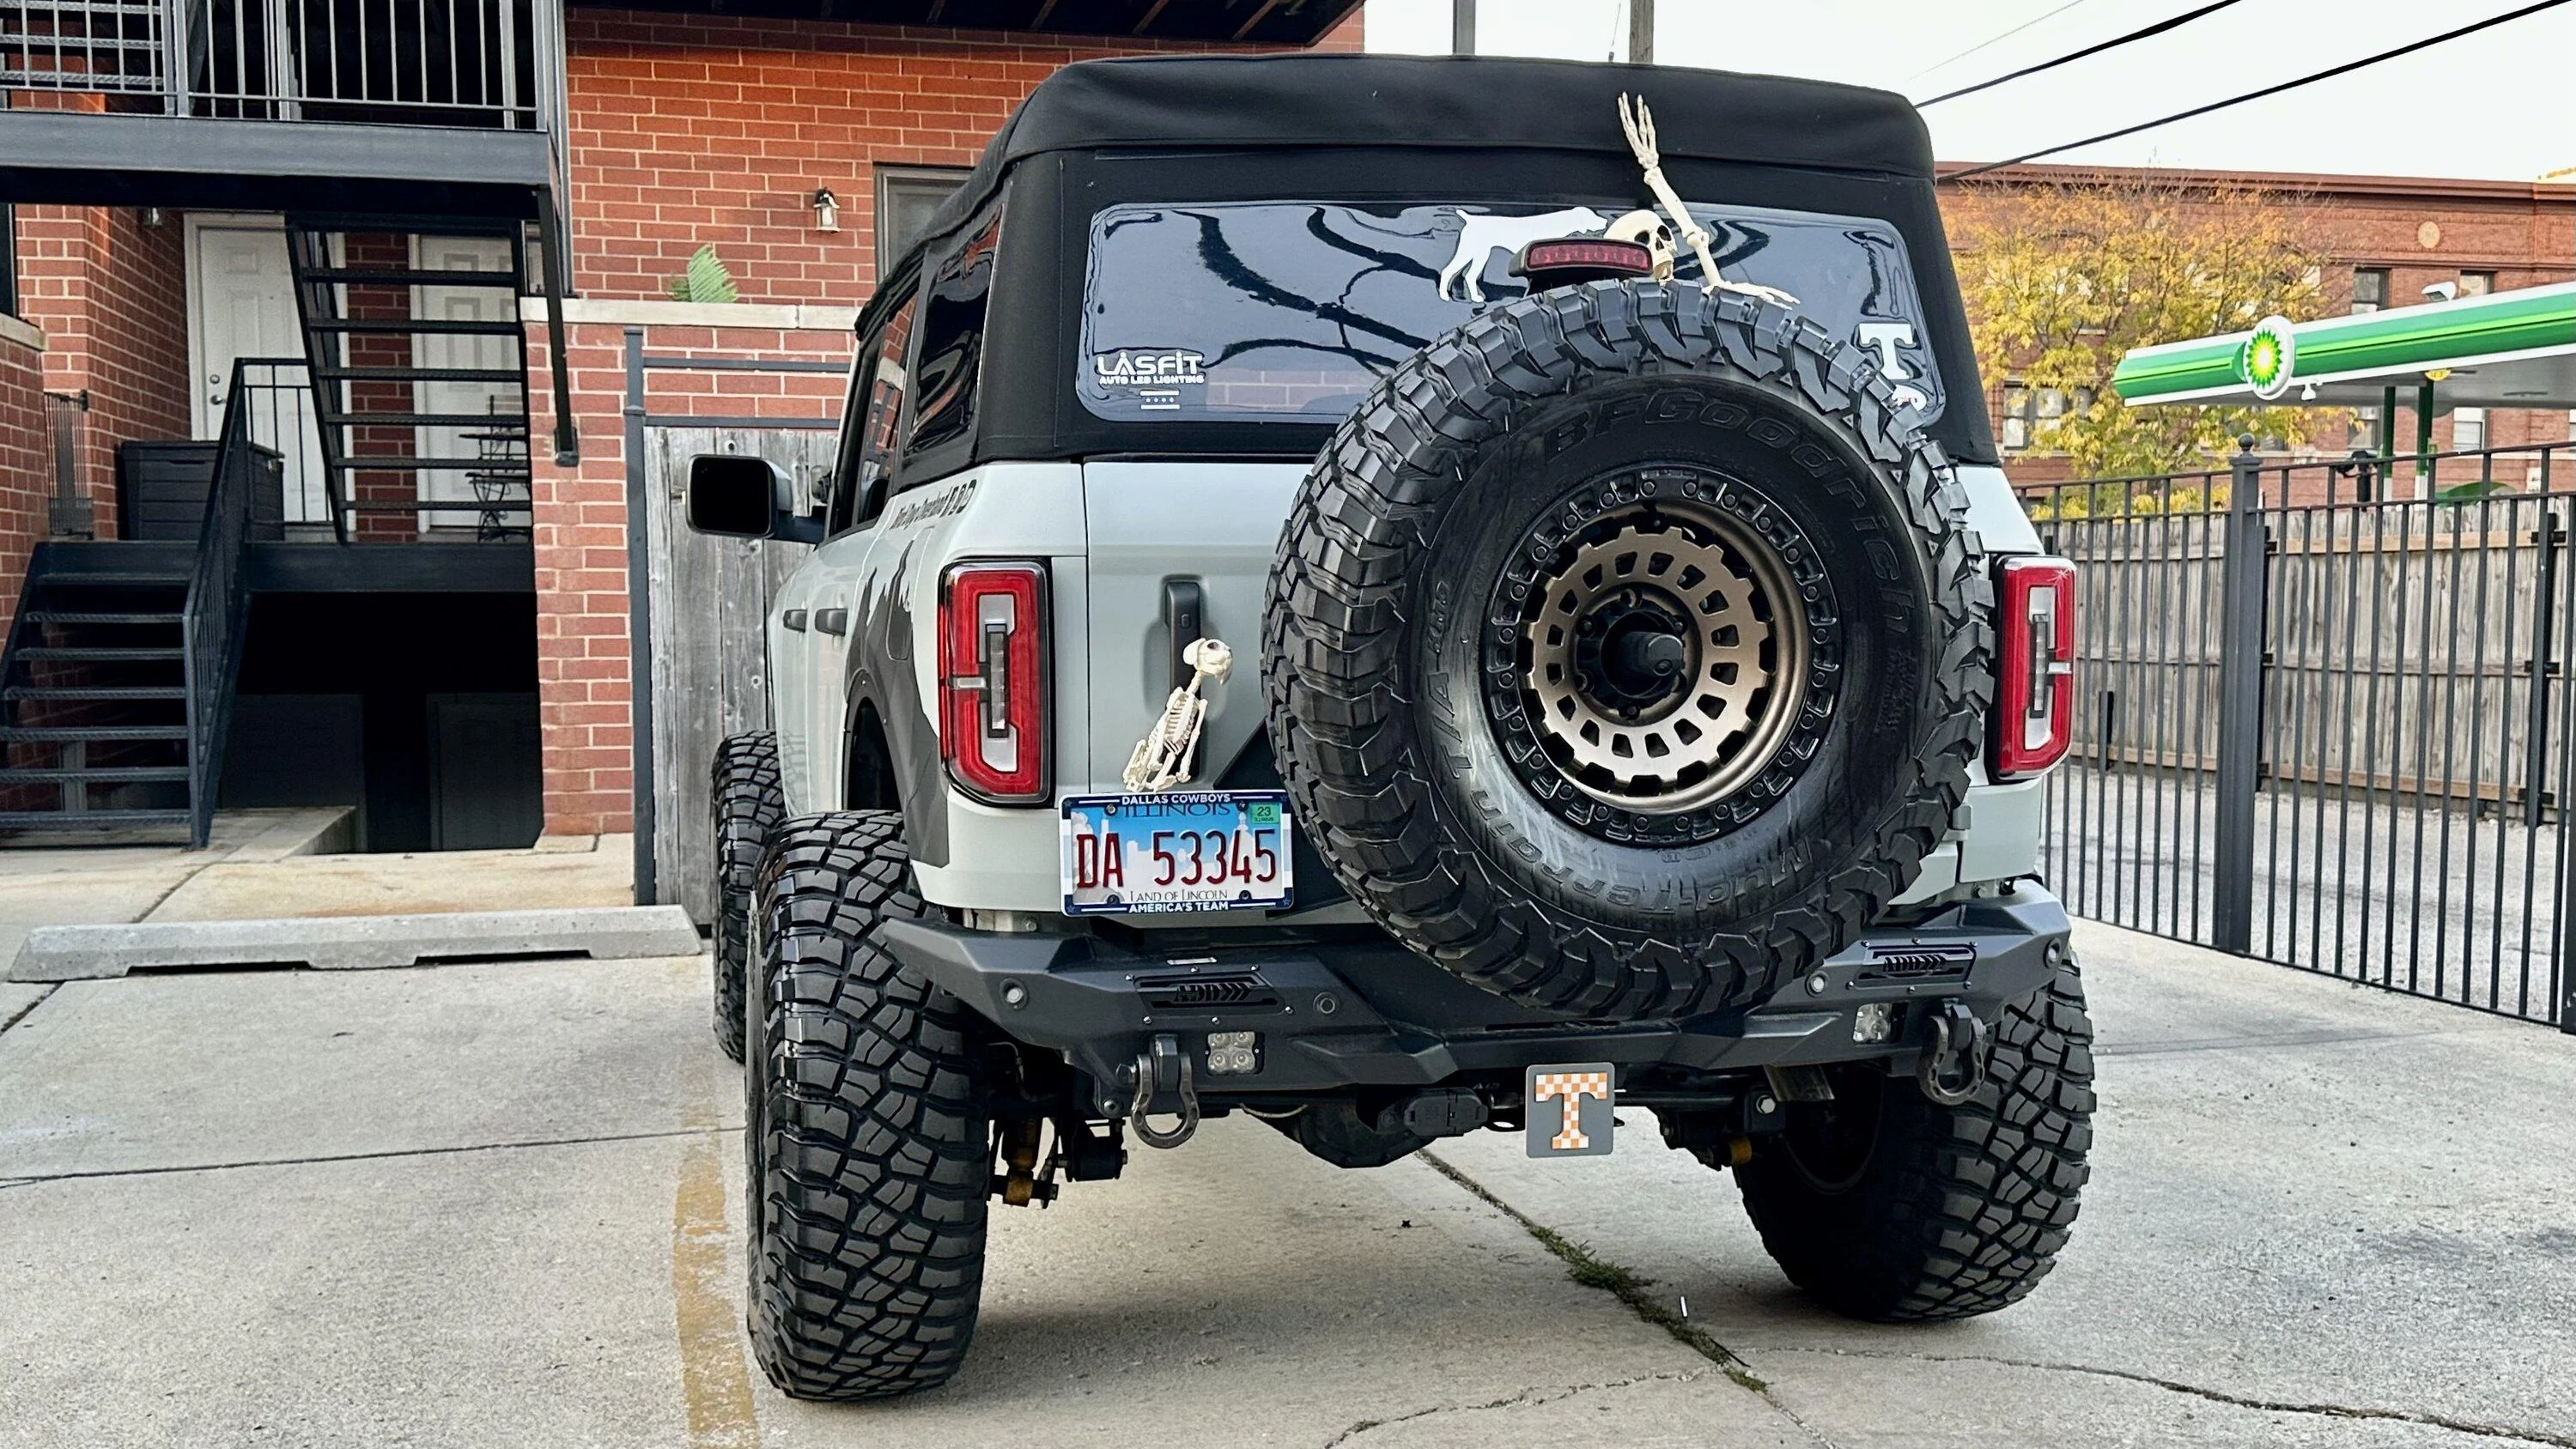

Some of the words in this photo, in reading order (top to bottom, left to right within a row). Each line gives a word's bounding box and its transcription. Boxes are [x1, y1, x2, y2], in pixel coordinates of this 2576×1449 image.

[1859, 323, 1913, 379] T
[1099, 375, 1129, 385] AUTO
[1130, 375, 1151, 385] LED
[1153, 375, 1205, 385] LIGHTING
[1121, 795, 1169, 805] DALLAS
[1170, 793, 1231, 803] COWBOYS
[1125, 803, 1230, 818] ILLINOIS
[1257, 806, 1271, 816] 23
[1076, 834, 1123, 888] DA
[1153, 829, 1276, 886] 53345
[1128, 902, 1194, 913] AMERICA'S
[1195, 900, 1229, 912] TEAM
[1535, 1072, 1607, 1149] T
